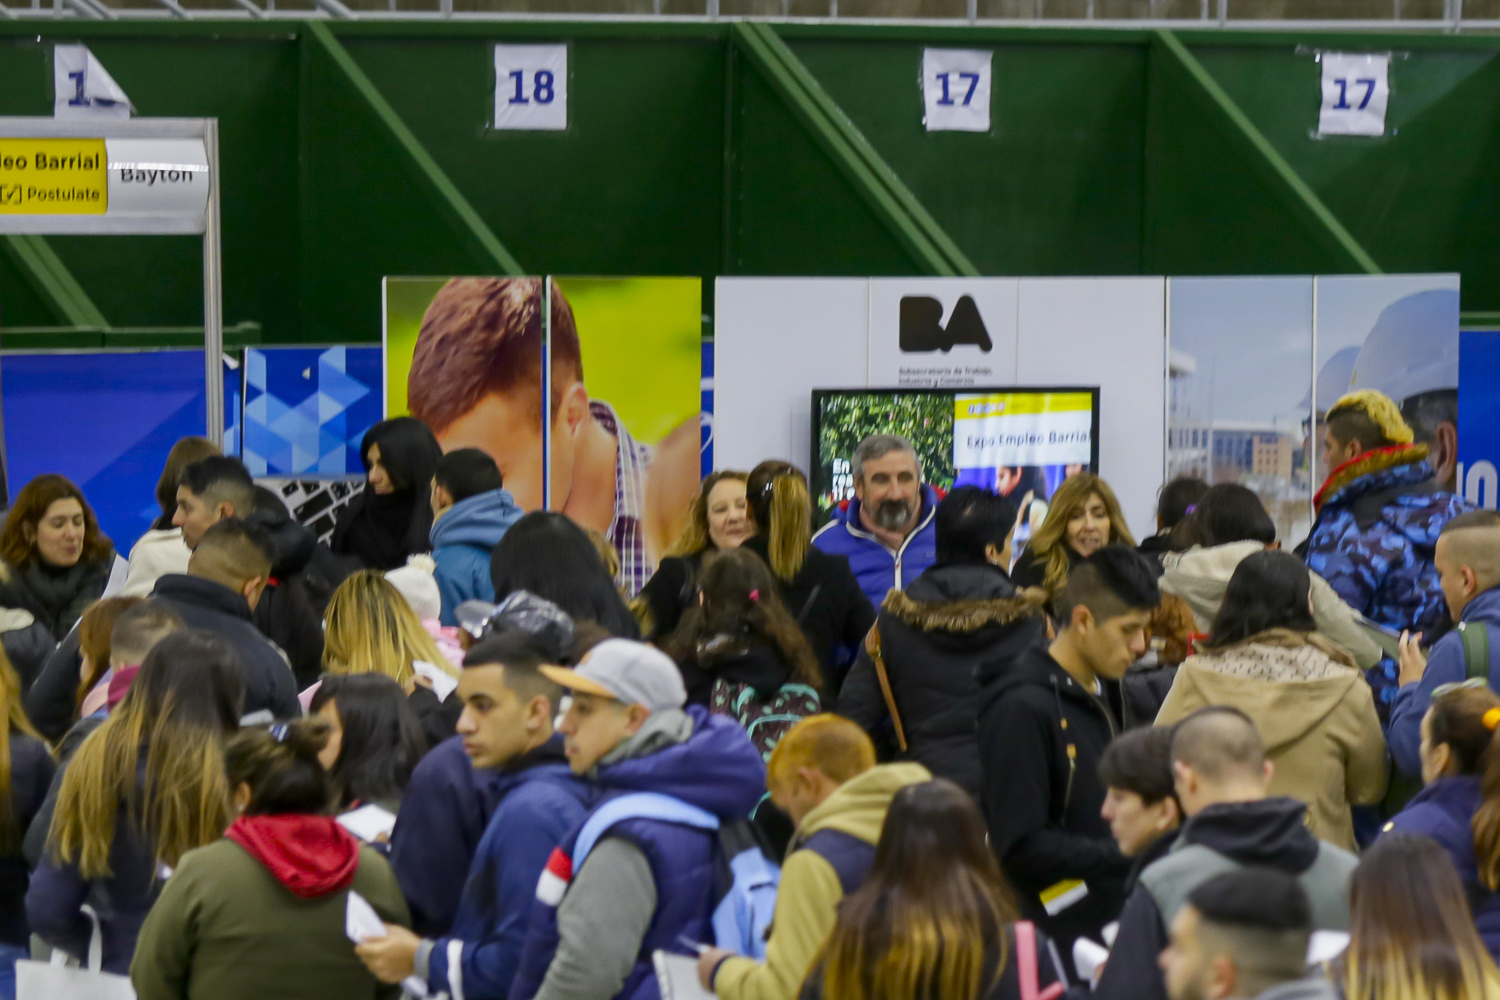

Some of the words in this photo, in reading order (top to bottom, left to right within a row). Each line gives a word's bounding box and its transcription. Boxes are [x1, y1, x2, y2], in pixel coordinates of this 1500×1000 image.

[509, 70, 554, 104] 18
[936, 72, 979, 106] 17
[1333, 79, 1375, 110] 17
[35, 152, 99, 171] Barrial
[121, 168, 193, 187] Bayton
[28, 186, 100, 202] Postulate
[899, 294, 993, 352] BA
